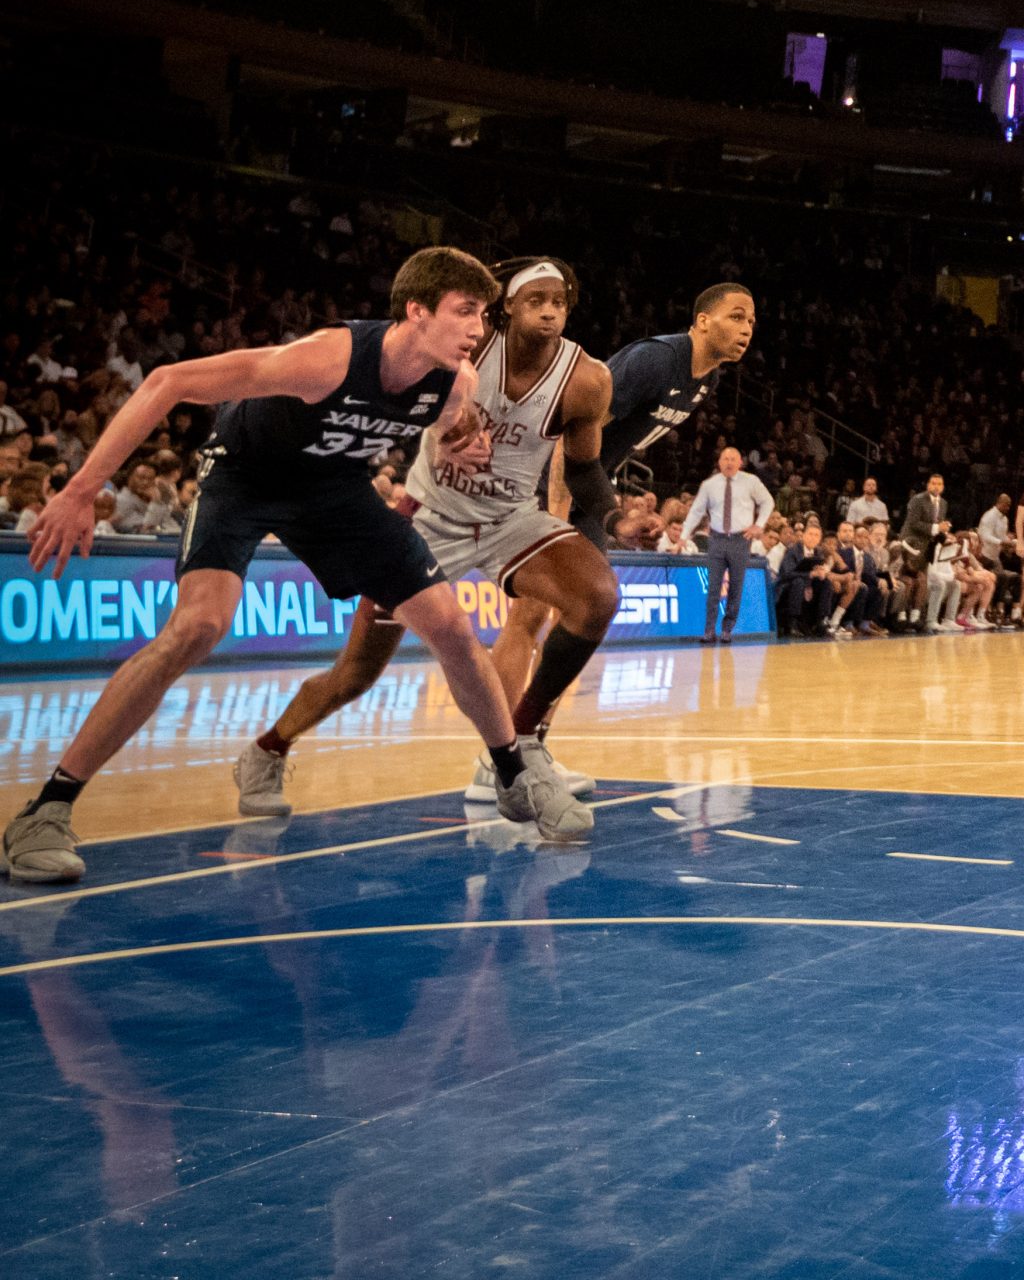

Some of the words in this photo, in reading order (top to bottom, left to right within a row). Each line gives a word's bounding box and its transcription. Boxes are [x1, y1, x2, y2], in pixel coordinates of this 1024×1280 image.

[321, 410, 423, 437] XAVIER
[1, 578, 178, 643] OMEN'
[233, 580, 329, 637] INAL
